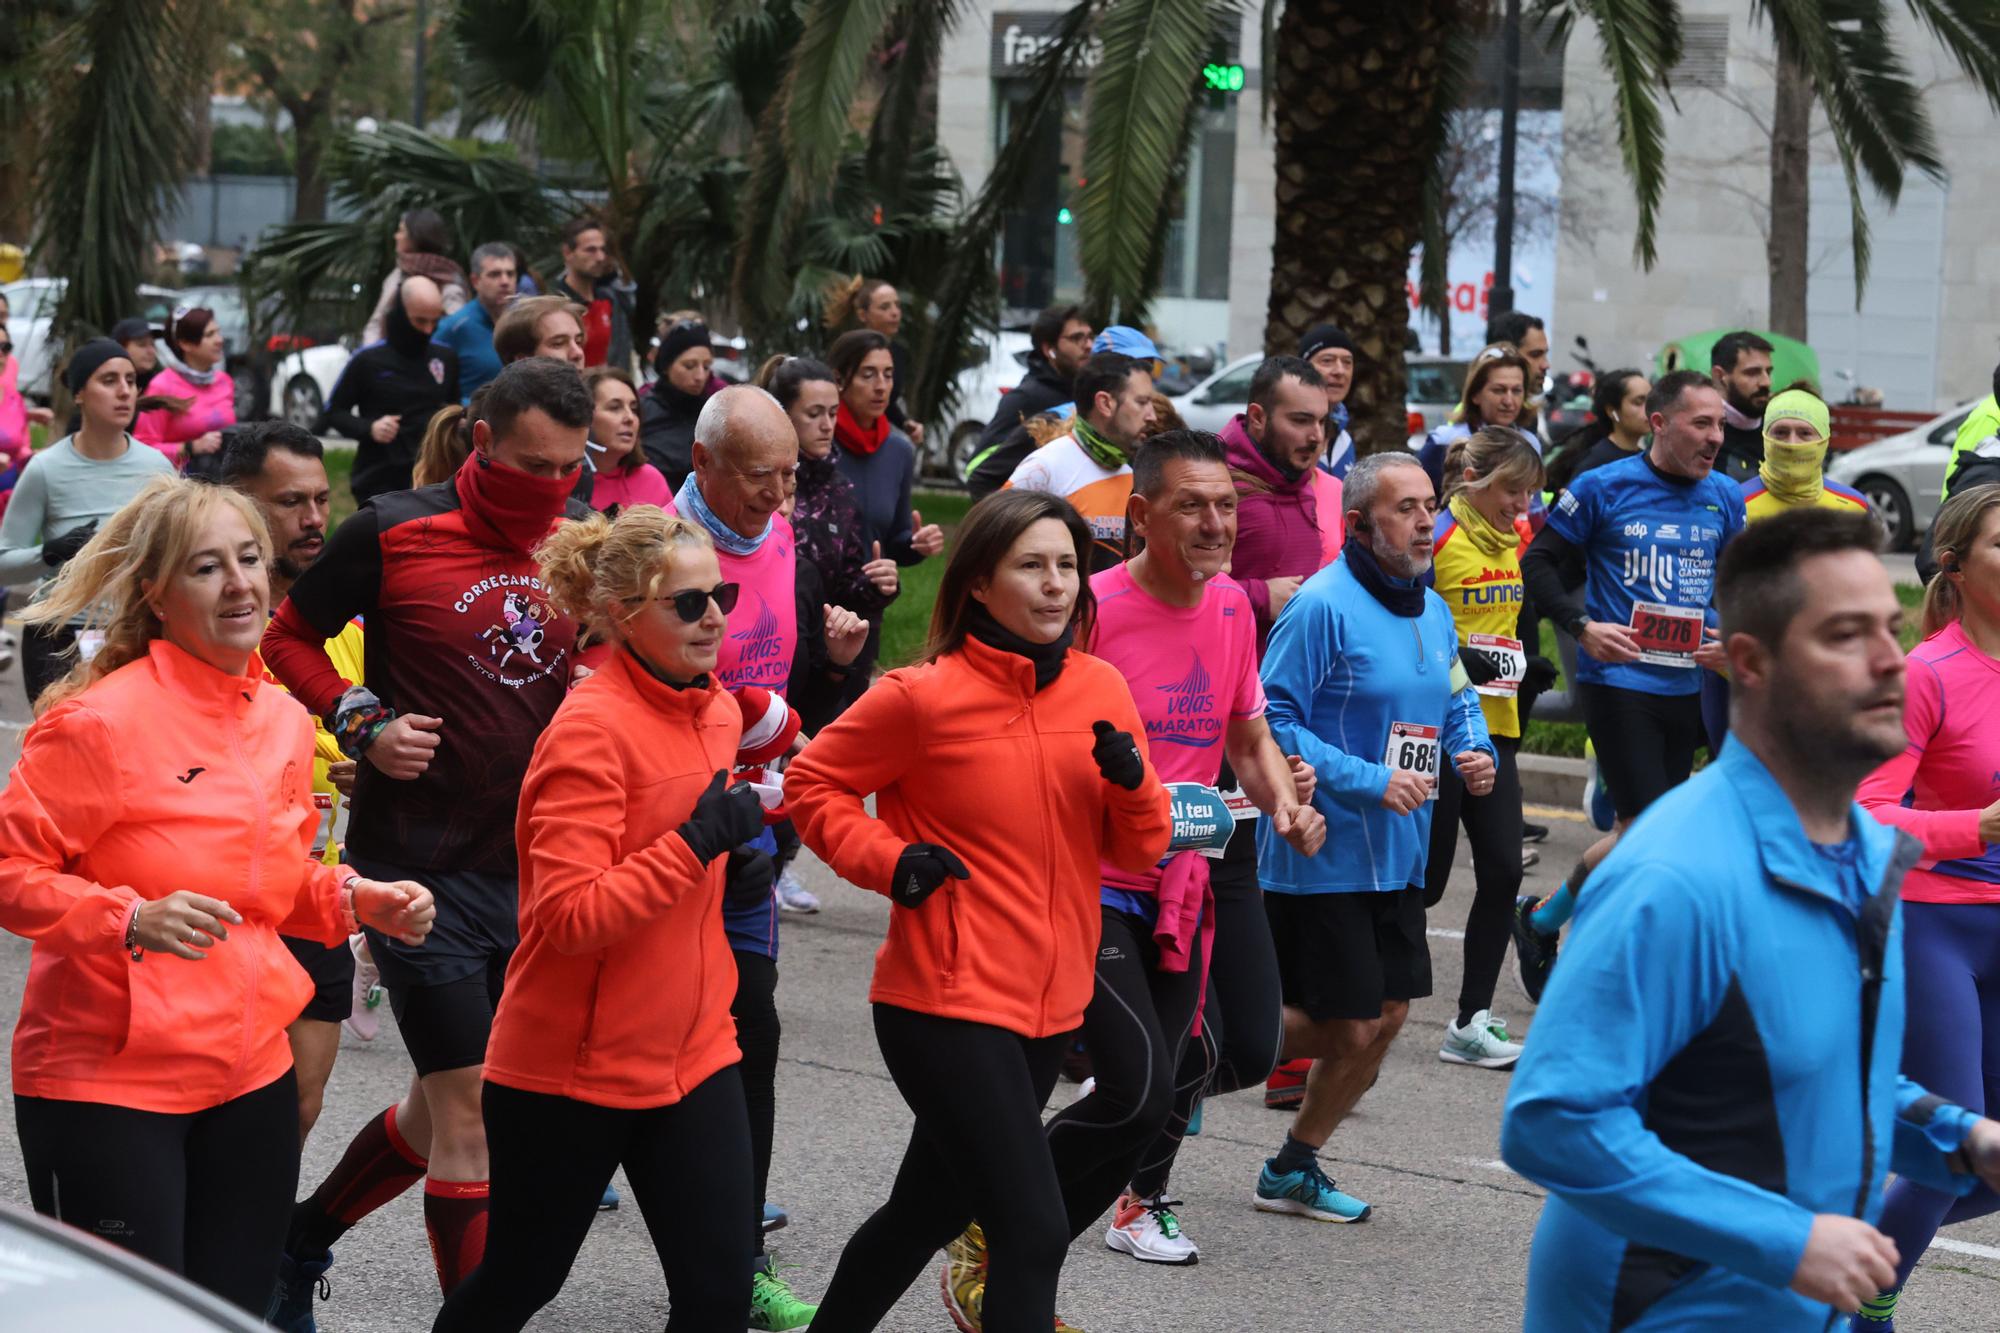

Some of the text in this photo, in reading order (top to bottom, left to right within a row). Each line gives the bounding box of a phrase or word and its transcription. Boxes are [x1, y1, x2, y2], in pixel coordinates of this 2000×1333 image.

[1624, 521, 1648, 539] edp
[1641, 615, 1693, 644] 2876
[739, 637, 783, 664] velas
[719, 660, 790, 684] MARATON
[1168, 693, 1215, 718] velas
[1145, 718, 1222, 734] MARATON
[1186, 799, 1213, 819] teu
[1174, 821, 1217, 838] Ritme
